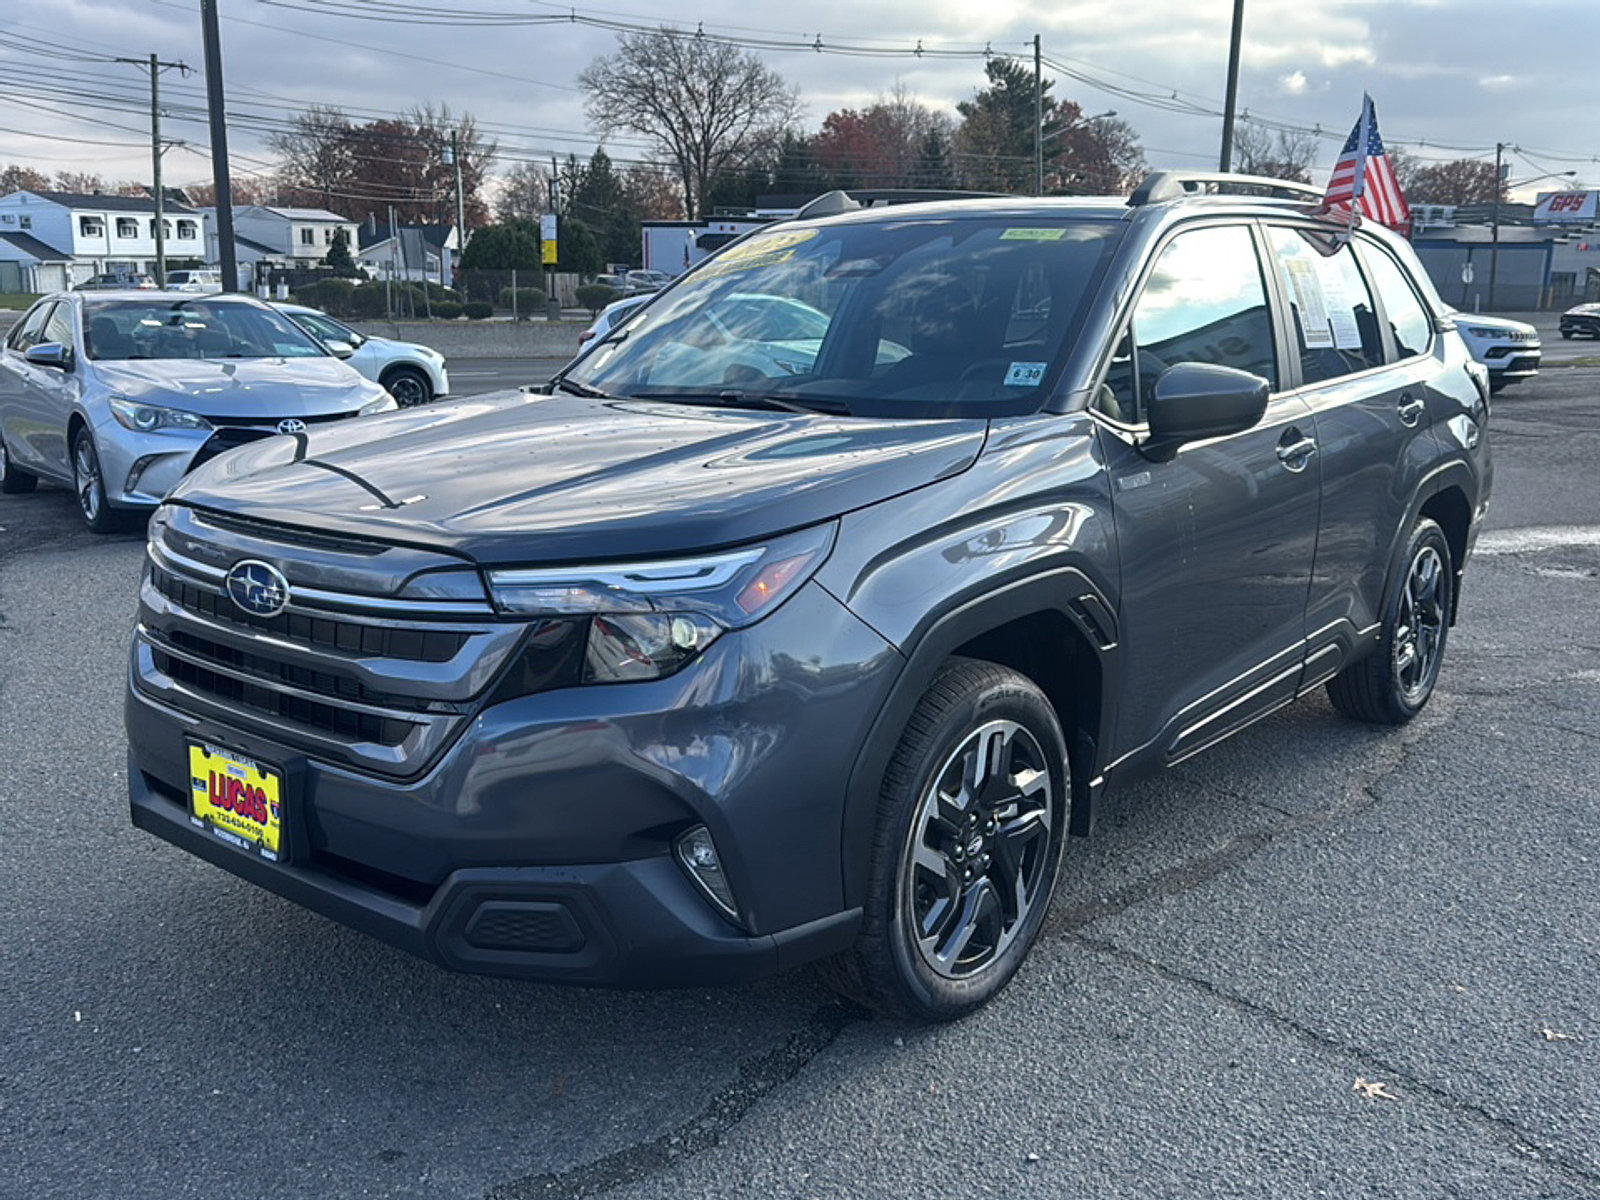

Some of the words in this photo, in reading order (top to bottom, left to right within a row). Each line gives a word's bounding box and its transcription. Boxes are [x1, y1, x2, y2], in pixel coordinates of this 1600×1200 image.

[1549, 195, 1587, 211] GPS
[1013, 369, 1021, 378] 6
[1025, 369, 1041, 379] 30
[209, 770, 268, 825] LUCAS
